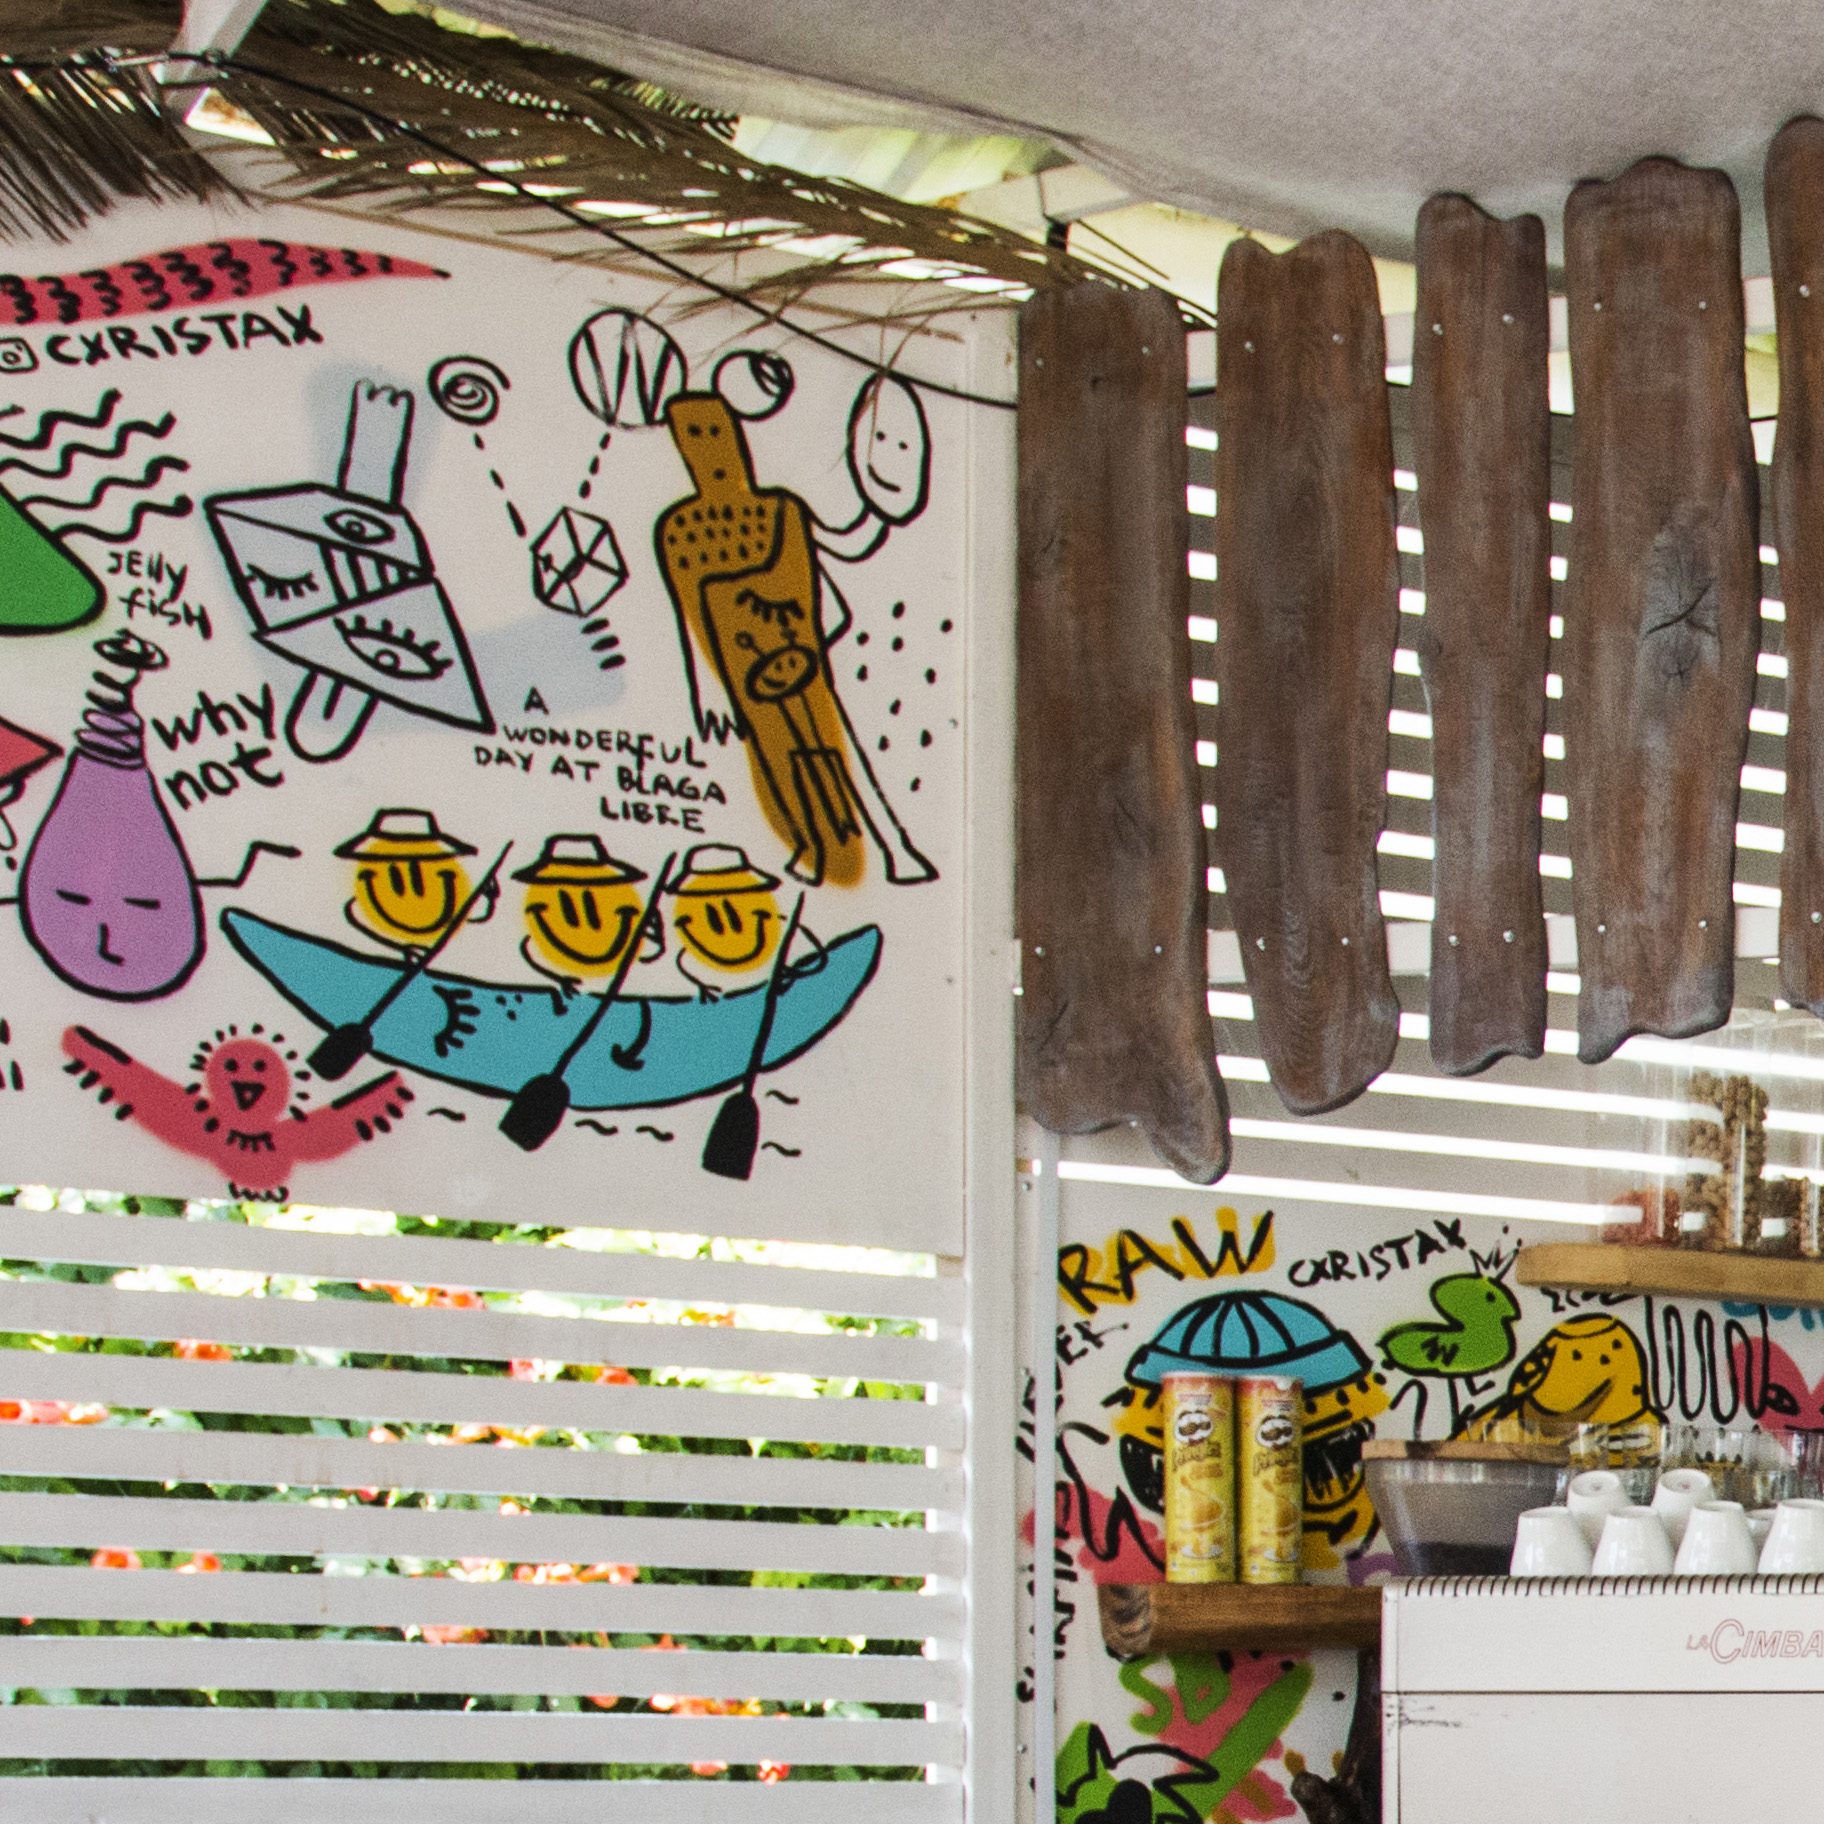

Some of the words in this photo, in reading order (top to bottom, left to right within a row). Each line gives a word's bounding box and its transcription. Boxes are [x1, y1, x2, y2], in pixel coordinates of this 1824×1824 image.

[524, 686, 549, 714] A
[504, 725, 707, 770] WONDERFUL
[165, 742, 285, 811] not
[474, 746, 533, 773] DAY
[551, 755, 600, 782] AT
[617, 765, 727, 804] BLAGA
[599, 796, 705, 833] LIBRE
[1060, 1211, 1274, 1316] RAW
